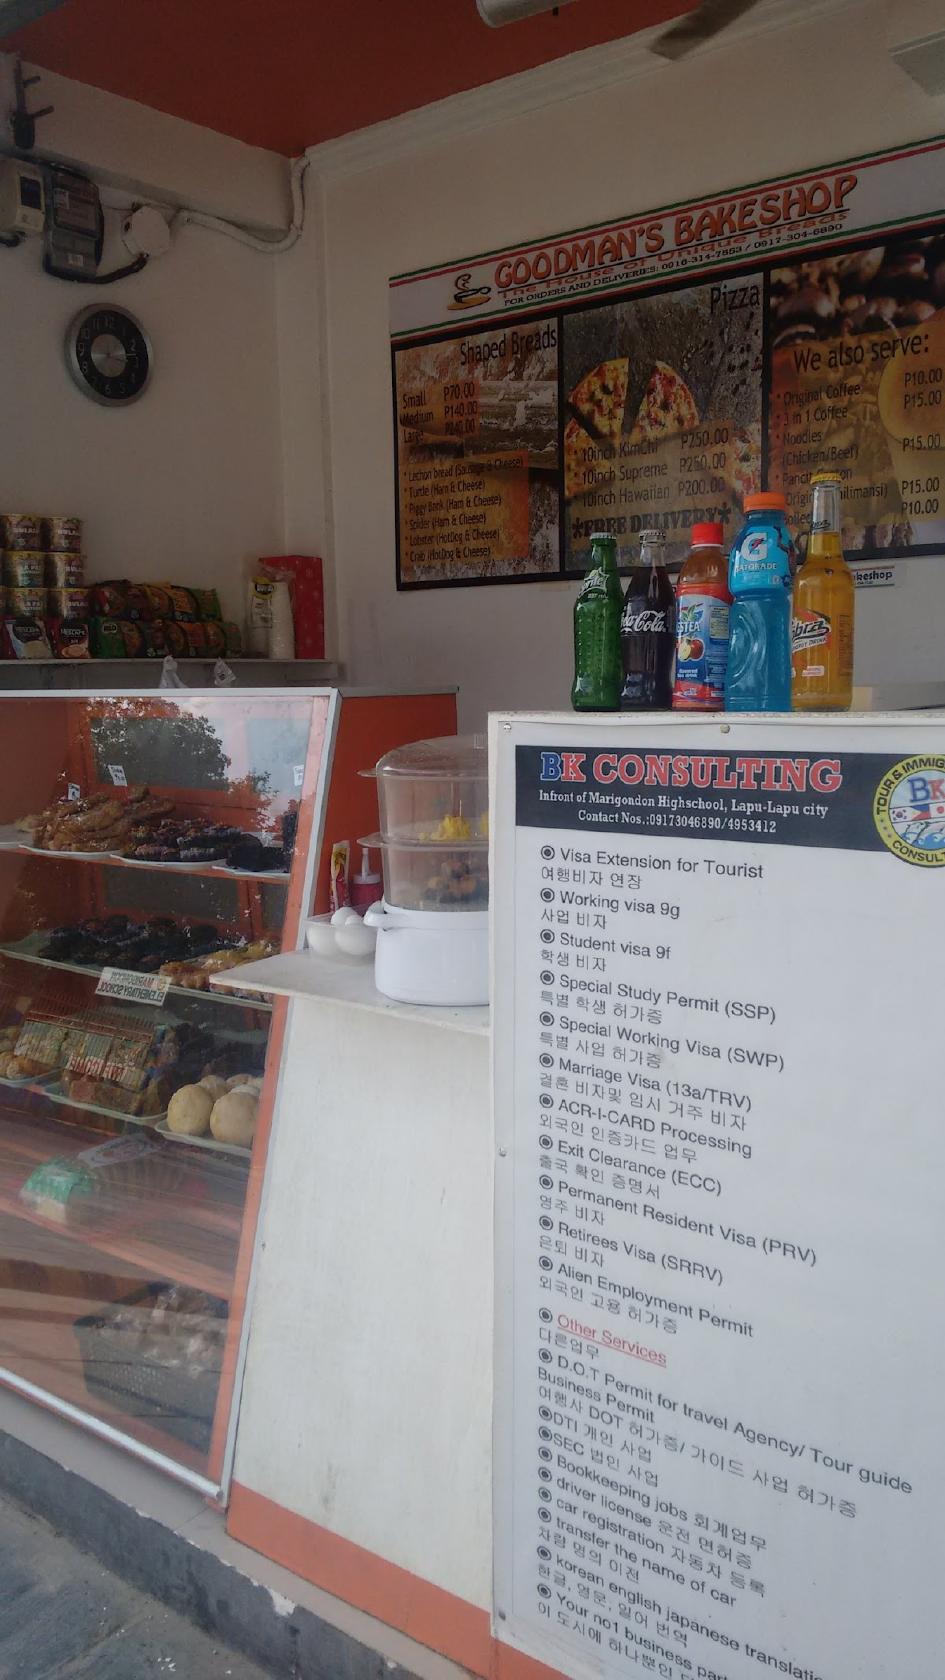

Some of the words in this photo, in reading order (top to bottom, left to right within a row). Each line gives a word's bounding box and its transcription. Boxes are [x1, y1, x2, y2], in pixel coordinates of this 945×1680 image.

[495, 222, 664, 289] GOODMAN'S
[675, 175, 858, 247] BAKESHOP
[624, 257, 646, 271] of
[504, 296, 522, 307] FOR
[526, 288, 565, 302] ORDERS
[568, 283, 591, 296] AND
[594, 265, 660, 290] DELIVERIES:
[709, 283, 761, 315] Pizza
[460, 333, 507, 367] Shaped
[511, 323, 558, 355] Breads
[793, 347, 821, 374] We
[827, 341, 865, 370] also
[871, 333, 929, 362] serve:
[402, 391, 427, 409] Small
[783, 389, 823, 408] Original
[825, 382, 860, 400] Coffee
[905, 367, 943, 388] P10.00
[813, 404, 848, 422] Coffee
[904, 390, 942, 410] P15.00
[582, 444, 616, 463] 10inch
[681, 427, 728, 449] P250.00
[903, 433, 941, 452] P15.00
[457, 480, 486, 494] Cheese)
[582, 466, 616, 486] 10inch
[619, 462, 669, 483] Supreme
[901, 477, 940, 496] P15.00
[473, 493, 502, 508] Cheese)
[582, 488, 616, 508] 10inch
[619, 483, 670, 503] Hawaiian
[901, 498, 939, 517] P10.00
[458, 512, 487, 526] Cheese)
[472, 528, 500, 542] Cheese)
[462, 544, 491, 558] Cheese)
[540, 752, 587, 783] BK
[592, 753, 844, 793] CONSULTING
[539, 789, 574, 803] Infront
[576, 791, 588, 804] of
[589, 792, 656, 810] Marigondon
[657, 795, 730, 813] Highschool,
[731, 798, 800, 818] Lapu-Lapu
[802, 804, 830, 820] city
[877, 778, 896, 816] TOUR
[578, 809, 619, 823] Contact
[541, 866, 603, 886] 여행비자
[610, 873, 642, 890] 연장
[560, 847, 592, 863] Visa
[597, 851, 671, 872] Extension
[677, 857, 699, 873] for
[703, 859, 763, 879] Tourist
[541, 908, 569, 925] 사업
[576, 912, 607, 930] 비자
[560, 890, 619, 913] Working
[625, 898, 656, 915] visa
[660, 902, 681, 920] 9g
[560, 932, 616, 953] Student
[620, 941, 652, 958] visa
[656, 945, 672, 960] 9f
[576, 953, 606, 972] 비자
[560, 974, 612, 995] Special
[617, 983, 662, 1006] Study
[667, 991, 720, 1013] Permit
[725, 1000, 776, 1025] (SSP)
[576, 996, 606, 1015] 학생
[613, 1002, 662, 1025] 허가증
[560, 1016, 612, 1038] Special
[616, 1025, 680, 1054] Working
[686, 1039, 721, 1059] Visa
[728, 1046, 784, 1073] (SWP)
[576, 1039, 605, 1058] 사업
[613, 1045, 662, 1069] 허가증
[559, 1057, 622, 1084] Marriage
[627, 1071, 661, 1092] Visa
[665, 1079, 752, 1113] (13a/TRV)
[558, 1098, 656, 1134] ACR-I-CARD
[661, 1121, 752, 1159] Processing
[668, 1100, 703, 1121] 거주
[711, 1109, 747, 1132] 비자
[539, 1113, 584, 1137] 외국인
[591, 1126, 656, 1155] 인증카드
[558, 1138, 584, 1160] Exit
[588, 1147, 666, 1180] Clearance
[671, 1168, 722, 1198] (ECC)
[612, 1172, 660, 1200] 증명서
[559, 1179, 637, 1216] Permanent
[643, 1203, 714, 1237] Resident
[719, 1225, 757, 1249] Visa
[762, 1237, 817, 1268] (PRV)
[575, 1204, 604, 1226] 비자
[559, 1221, 618, 1252] Retirees
[623, 1241, 656, 1264] Visa
[661, 1253, 723, 1287] (SRRV)
[575, 1246, 604, 1269] 비자
[557, 1263, 593, 1286] Alien
[597, 1276, 693, 1319] Employment
[699, 1308, 754, 1338] Permit
[557, 1314, 597, 1339] Other
[602, 1330, 668, 1366] Services
[538, 1366, 601, 1403] Business
[606, 1392, 655, 1424] Permit
[553, 1412, 578, 1433] DTI
[558, 1355, 600, 1381] D.O.T
[604, 1373, 653, 1404] Permit
[657, 1393, 679, 1413] for
[683, 1402, 728, 1431] travel
[733, 1422, 806, 1457] Agency/
[809, 1447, 854, 1475] Tour
[859, 1467, 914, 1494] guide
[553, 1432, 585, 1457] SEC
[589, 1405, 624, 1429] DOT
[797, 1485, 857, 1519] 허가증
[556, 1478, 597, 1503] driver
[601, 1495, 652, 1527] license
[557, 1454, 651, 1508] Bookkeeping
[654, 1496, 688, 1522] jobs
[556, 1498, 579, 1515] car
[582, 1510, 664, 1555] registration
[556, 1516, 609, 1550] transfer
[615, 1543, 638, 1564] the
[642, 1558, 686, 1586] name
[690, 1580, 706, 1594] of
[710, 1588, 737, 1608] car
[556, 1554, 604, 1588] korean
[609, 1582, 662, 1616] english
[666, 1607, 741, 1652] japanese
[556, 1591, 589, 1618] Your
[624, 1626, 692, 1672] business
